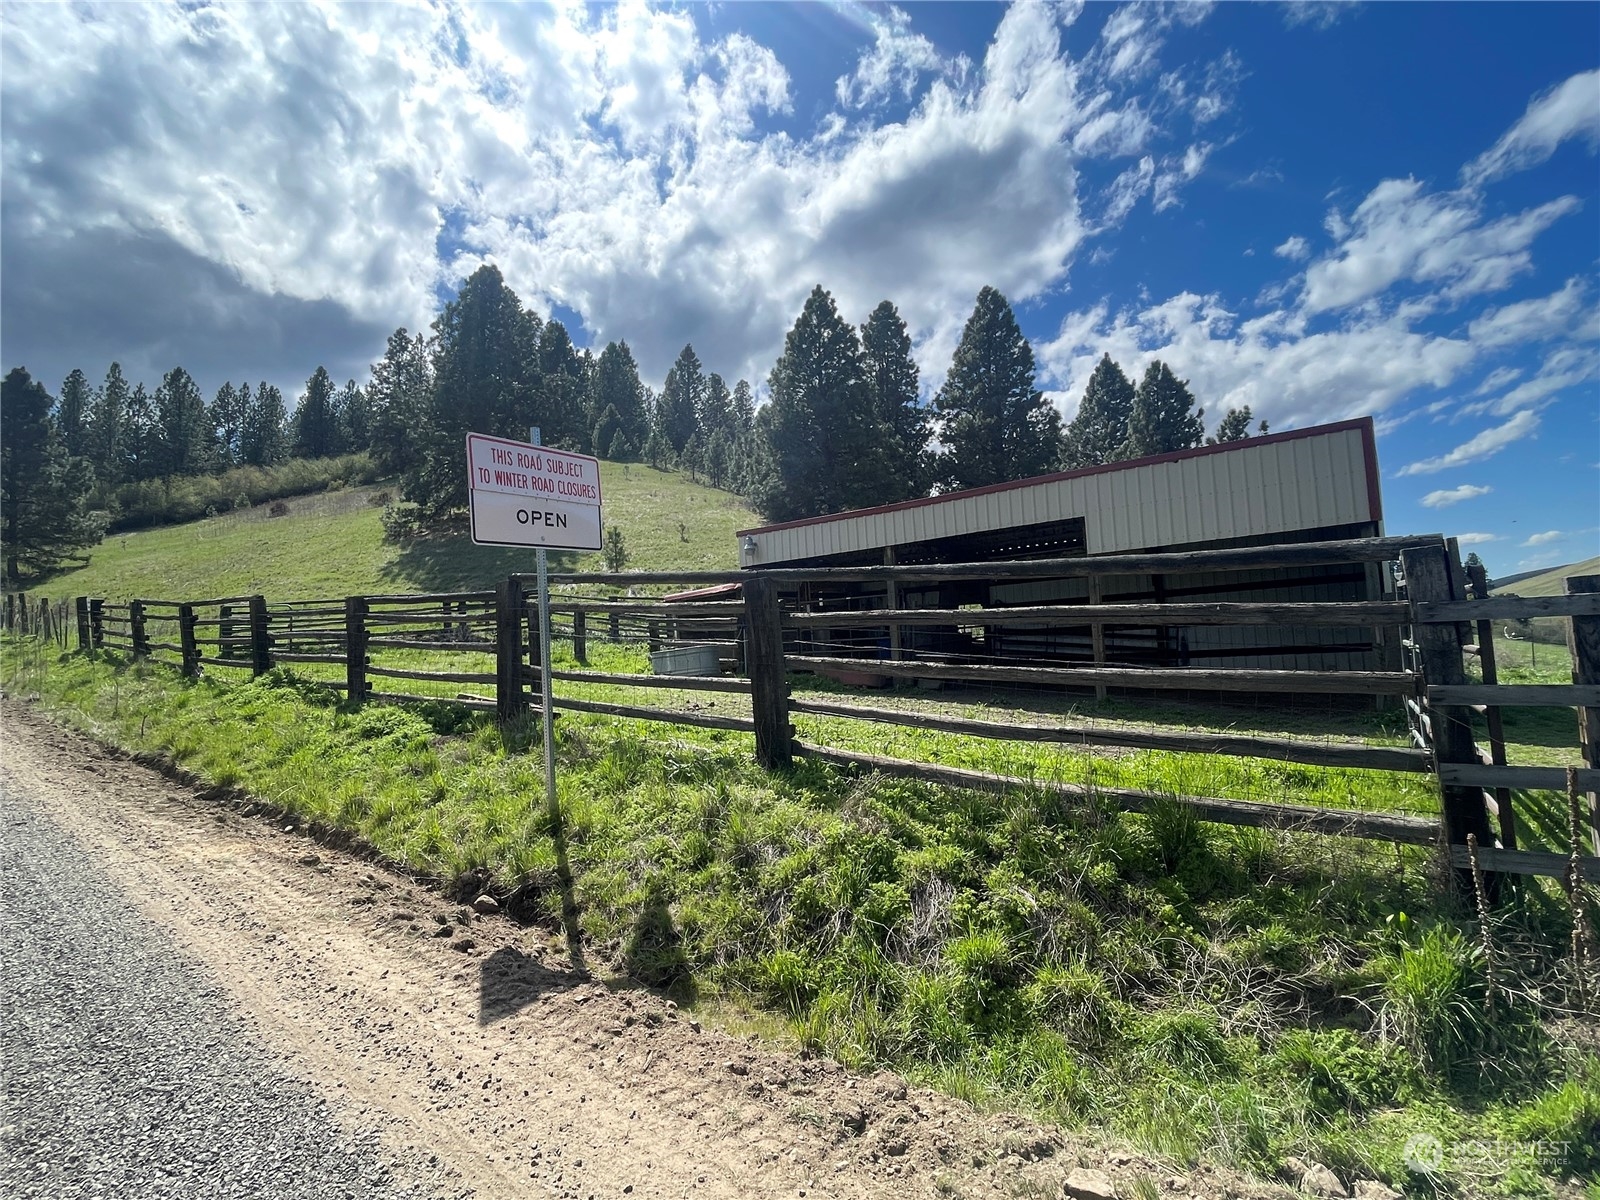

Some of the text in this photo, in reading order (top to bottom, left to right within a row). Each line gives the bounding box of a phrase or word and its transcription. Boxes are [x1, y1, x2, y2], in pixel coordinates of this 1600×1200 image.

[491, 448, 583, 478] THIS ROAD SUBJECT
[478, 467, 596, 499] TO WINTER ROAD CLOSURES
[516, 509, 567, 528] OPEN
